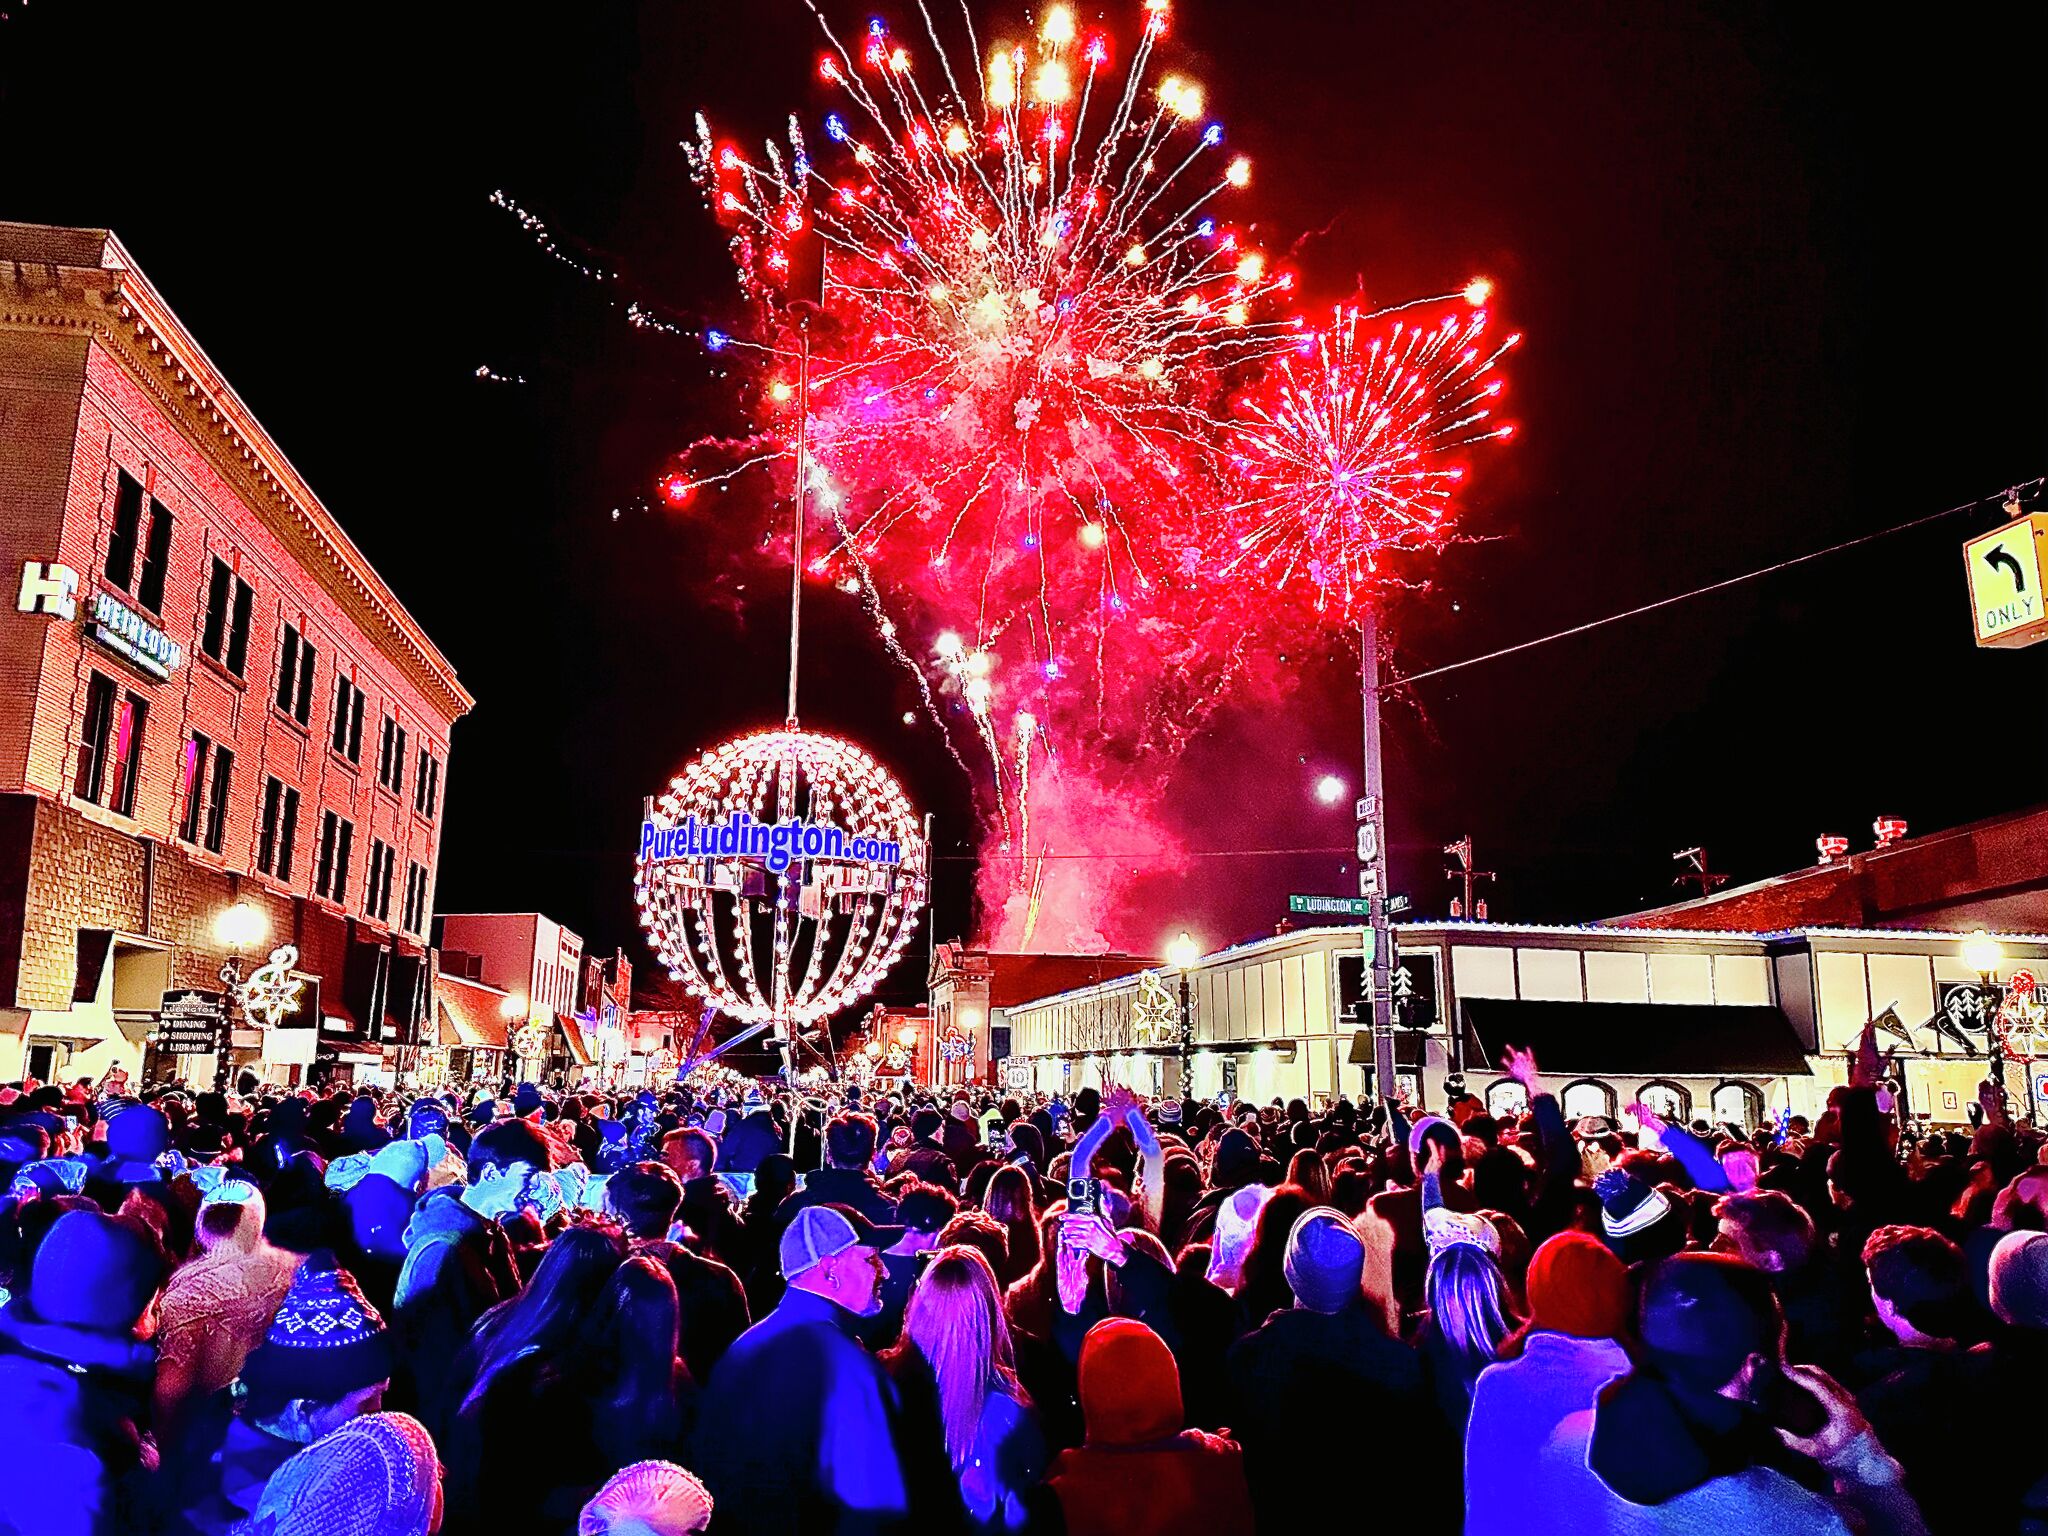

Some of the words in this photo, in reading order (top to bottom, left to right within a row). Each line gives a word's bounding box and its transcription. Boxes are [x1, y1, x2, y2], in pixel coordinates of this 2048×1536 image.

[1986, 596, 2033, 629] ONLY
[1360, 799, 1373, 814] WEST
[641, 811, 900, 872] PureLudington.com
[1361, 830, 1373, 853] 10
[1306, 898, 1352, 913] LUDINGTON
[172, 1020, 207, 1029] DINING
[170, 1031, 213, 1041] SHOPPING
[169, 1042, 208, 1052] LIBRARY
[1010, 1057, 1026, 1065] WEST
[1012, 1070, 1024, 1084] 10
